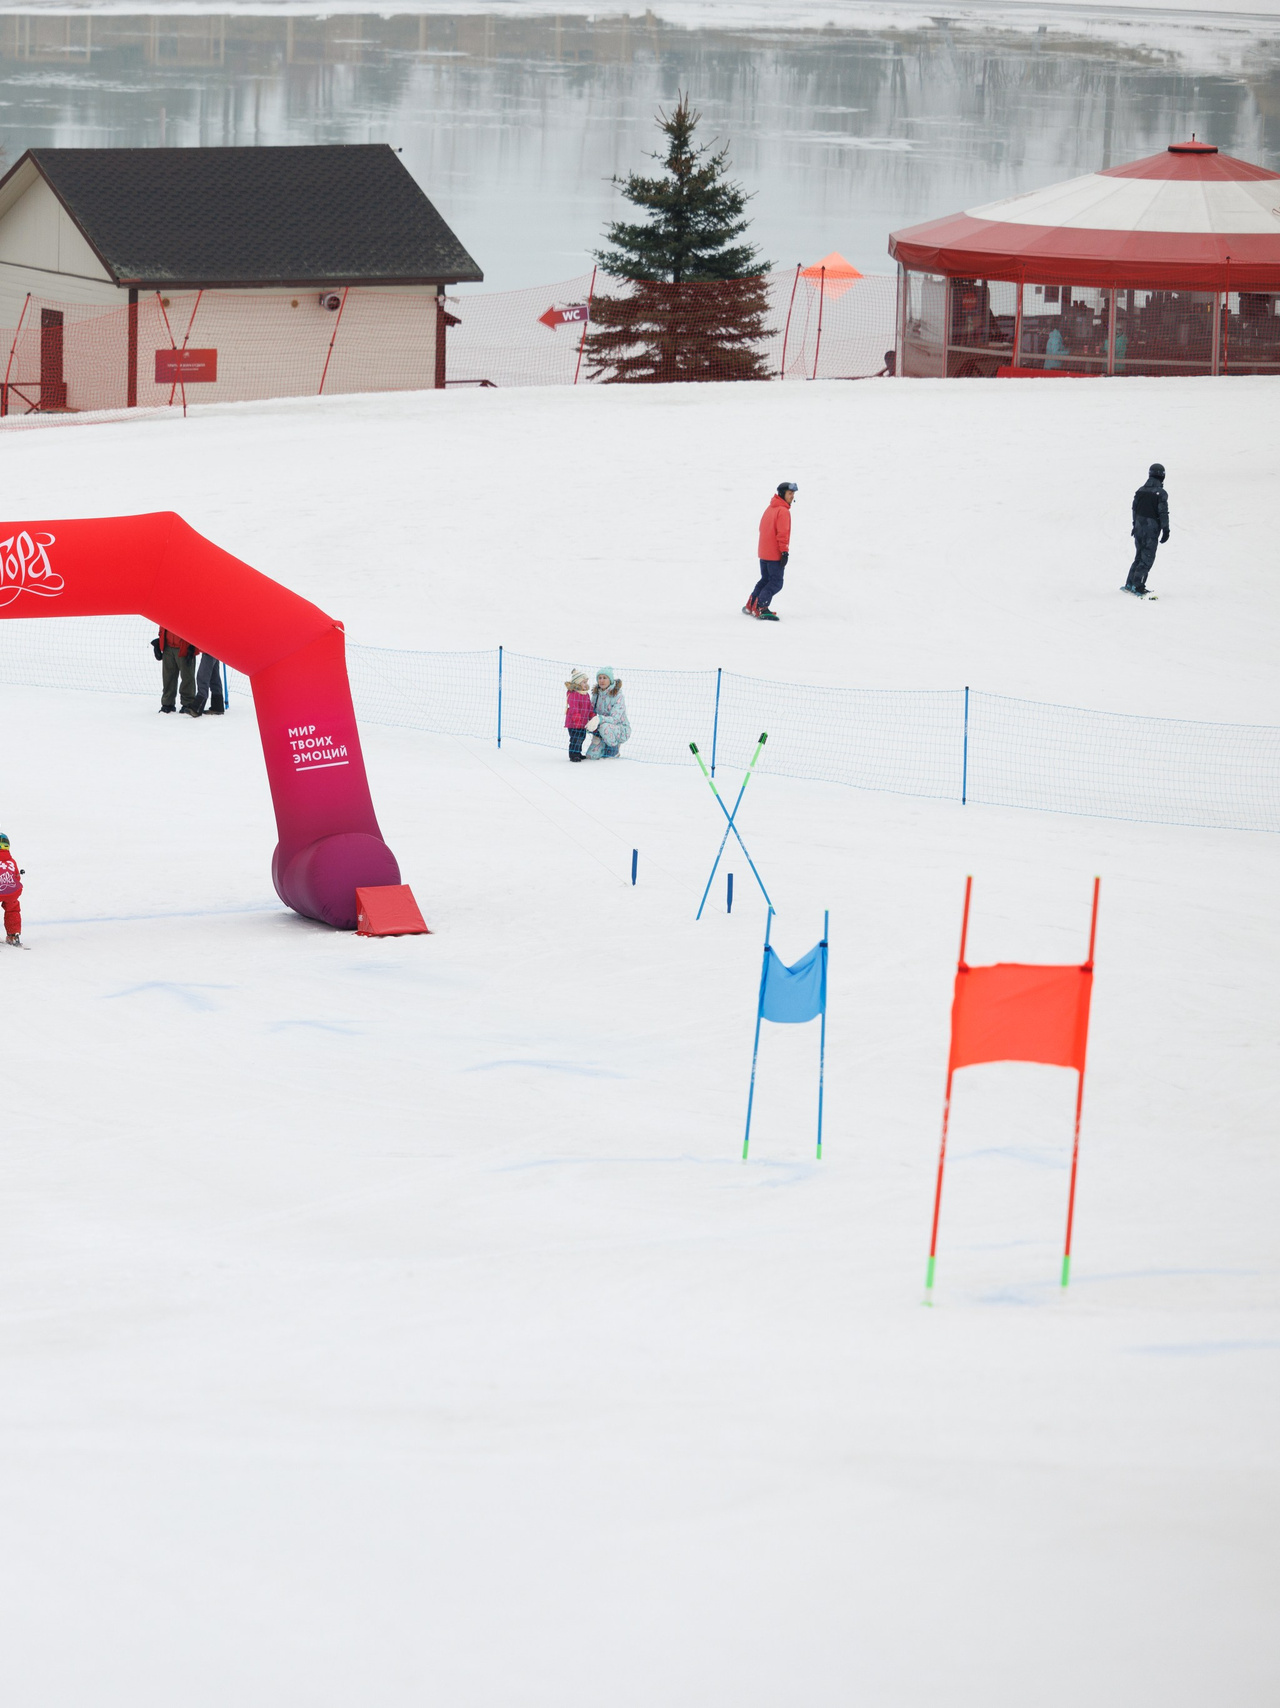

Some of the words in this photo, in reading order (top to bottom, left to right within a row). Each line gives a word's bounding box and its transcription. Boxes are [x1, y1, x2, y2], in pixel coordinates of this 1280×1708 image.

[562, 310, 581, 321] WC
[287, 724, 316, 738] МИР
[289, 735, 333, 751] ТВОИХ
[292, 745, 348, 764] ЭМОЦИЙ
